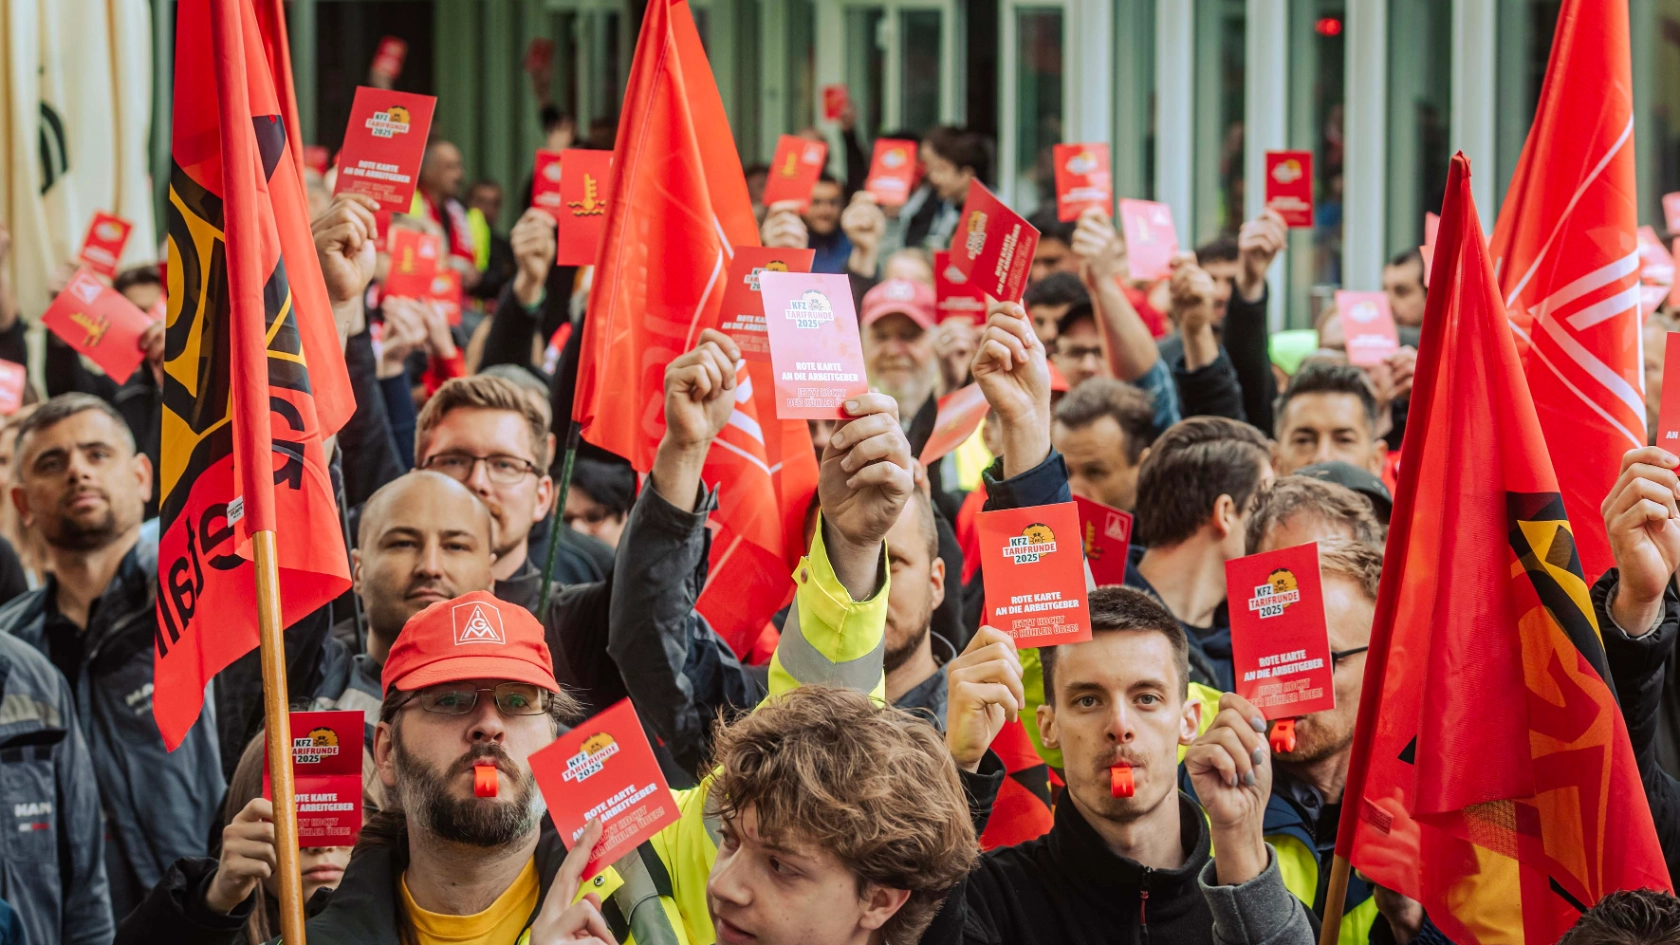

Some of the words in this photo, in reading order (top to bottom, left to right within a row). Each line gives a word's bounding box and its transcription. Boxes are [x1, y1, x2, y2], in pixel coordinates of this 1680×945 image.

[373, 129, 392, 137] 2025
[792, 301, 807, 310] KFZ
[786, 310, 833, 320] TARIFRUNDE
[798, 319, 818, 328] 2025
[796, 362, 816, 371] ROTE
[817, 363, 842, 371] KARTE
[782, 372, 793, 381] AN
[794, 372, 807, 381] DIE
[808, 373, 859, 382] ARBEITGEBER
[1666, 431, 1679, 439] AN
[1011, 537, 1028, 546] KFZ
[1004, 543, 1055, 556] TARIFRUNDE
[1016, 553, 1038, 563] 2025
[1256, 585, 1272, 598] KFZ
[1011, 594, 1033, 604] ROTE
[1034, 591, 1061, 602] KARTE
[1250, 591, 1298, 610] TARIFRUNDE
[995, 607, 1008, 616] AN
[1008, 605, 1023, 614] DIE
[1024, 600, 1080, 613] ARBEITGEBER
[1261, 605, 1282, 617] 2025
[1259, 655, 1280, 668] ROTE
[1280, 650, 1306, 663] KARTE
[1244, 671, 1256, 682] AN
[1256, 668, 1271, 679] DIE
[1271, 658, 1323, 677] ARBEITGEBER
[292, 747, 337, 755] ARIFRUNDE
[564, 745, 617, 780] TARIFRUNDE
[569, 753, 588, 768] KFZ
[577, 762, 602, 781] 2025
[295, 794, 309, 802] OTE
[310, 793, 337, 802] KARTE
[583, 800, 607, 821] ROTE
[606, 783, 637, 807] KARTE
[600, 782, 658, 823] ARBEITGEBER
[300, 803, 354, 812] ARBEITGEBER
[298, 826, 325, 837] ÜHLER
